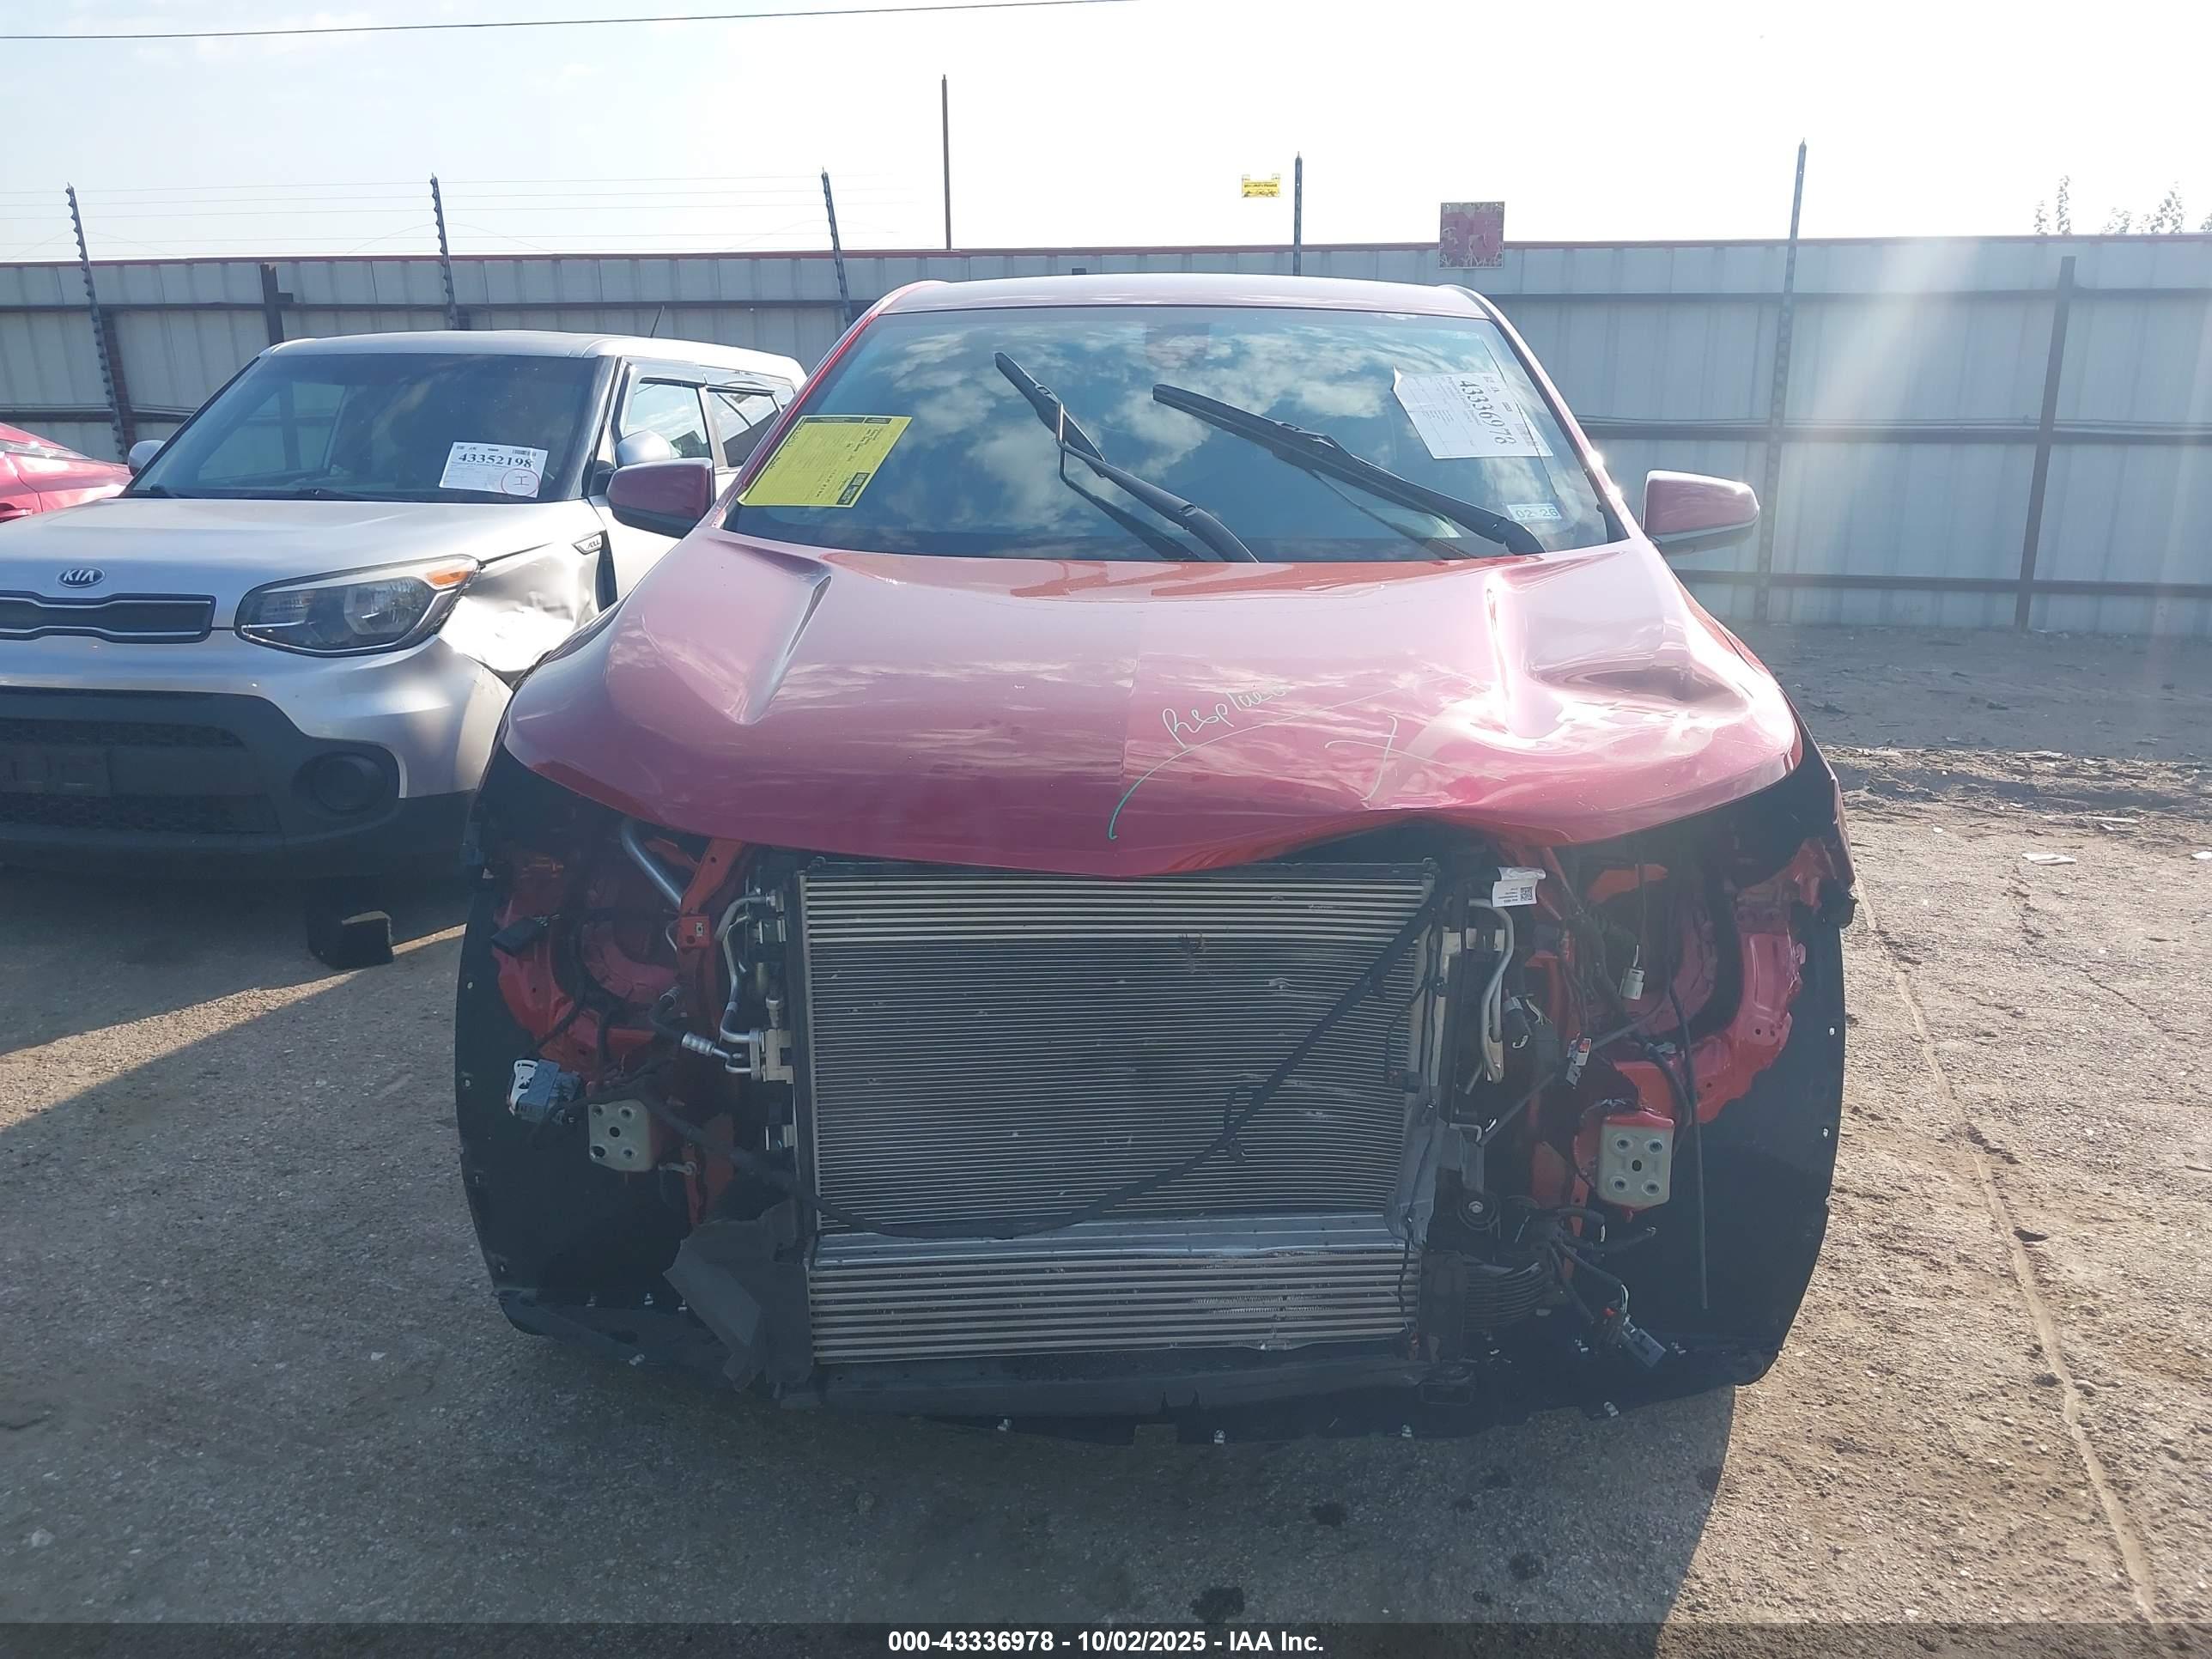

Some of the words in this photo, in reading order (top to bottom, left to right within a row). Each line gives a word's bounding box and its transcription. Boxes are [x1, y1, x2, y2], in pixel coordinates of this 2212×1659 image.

[1459, 380, 1517, 446] 43336978
[458, 453, 534, 468] 43352198
[64, 570, 94, 581] KIA
